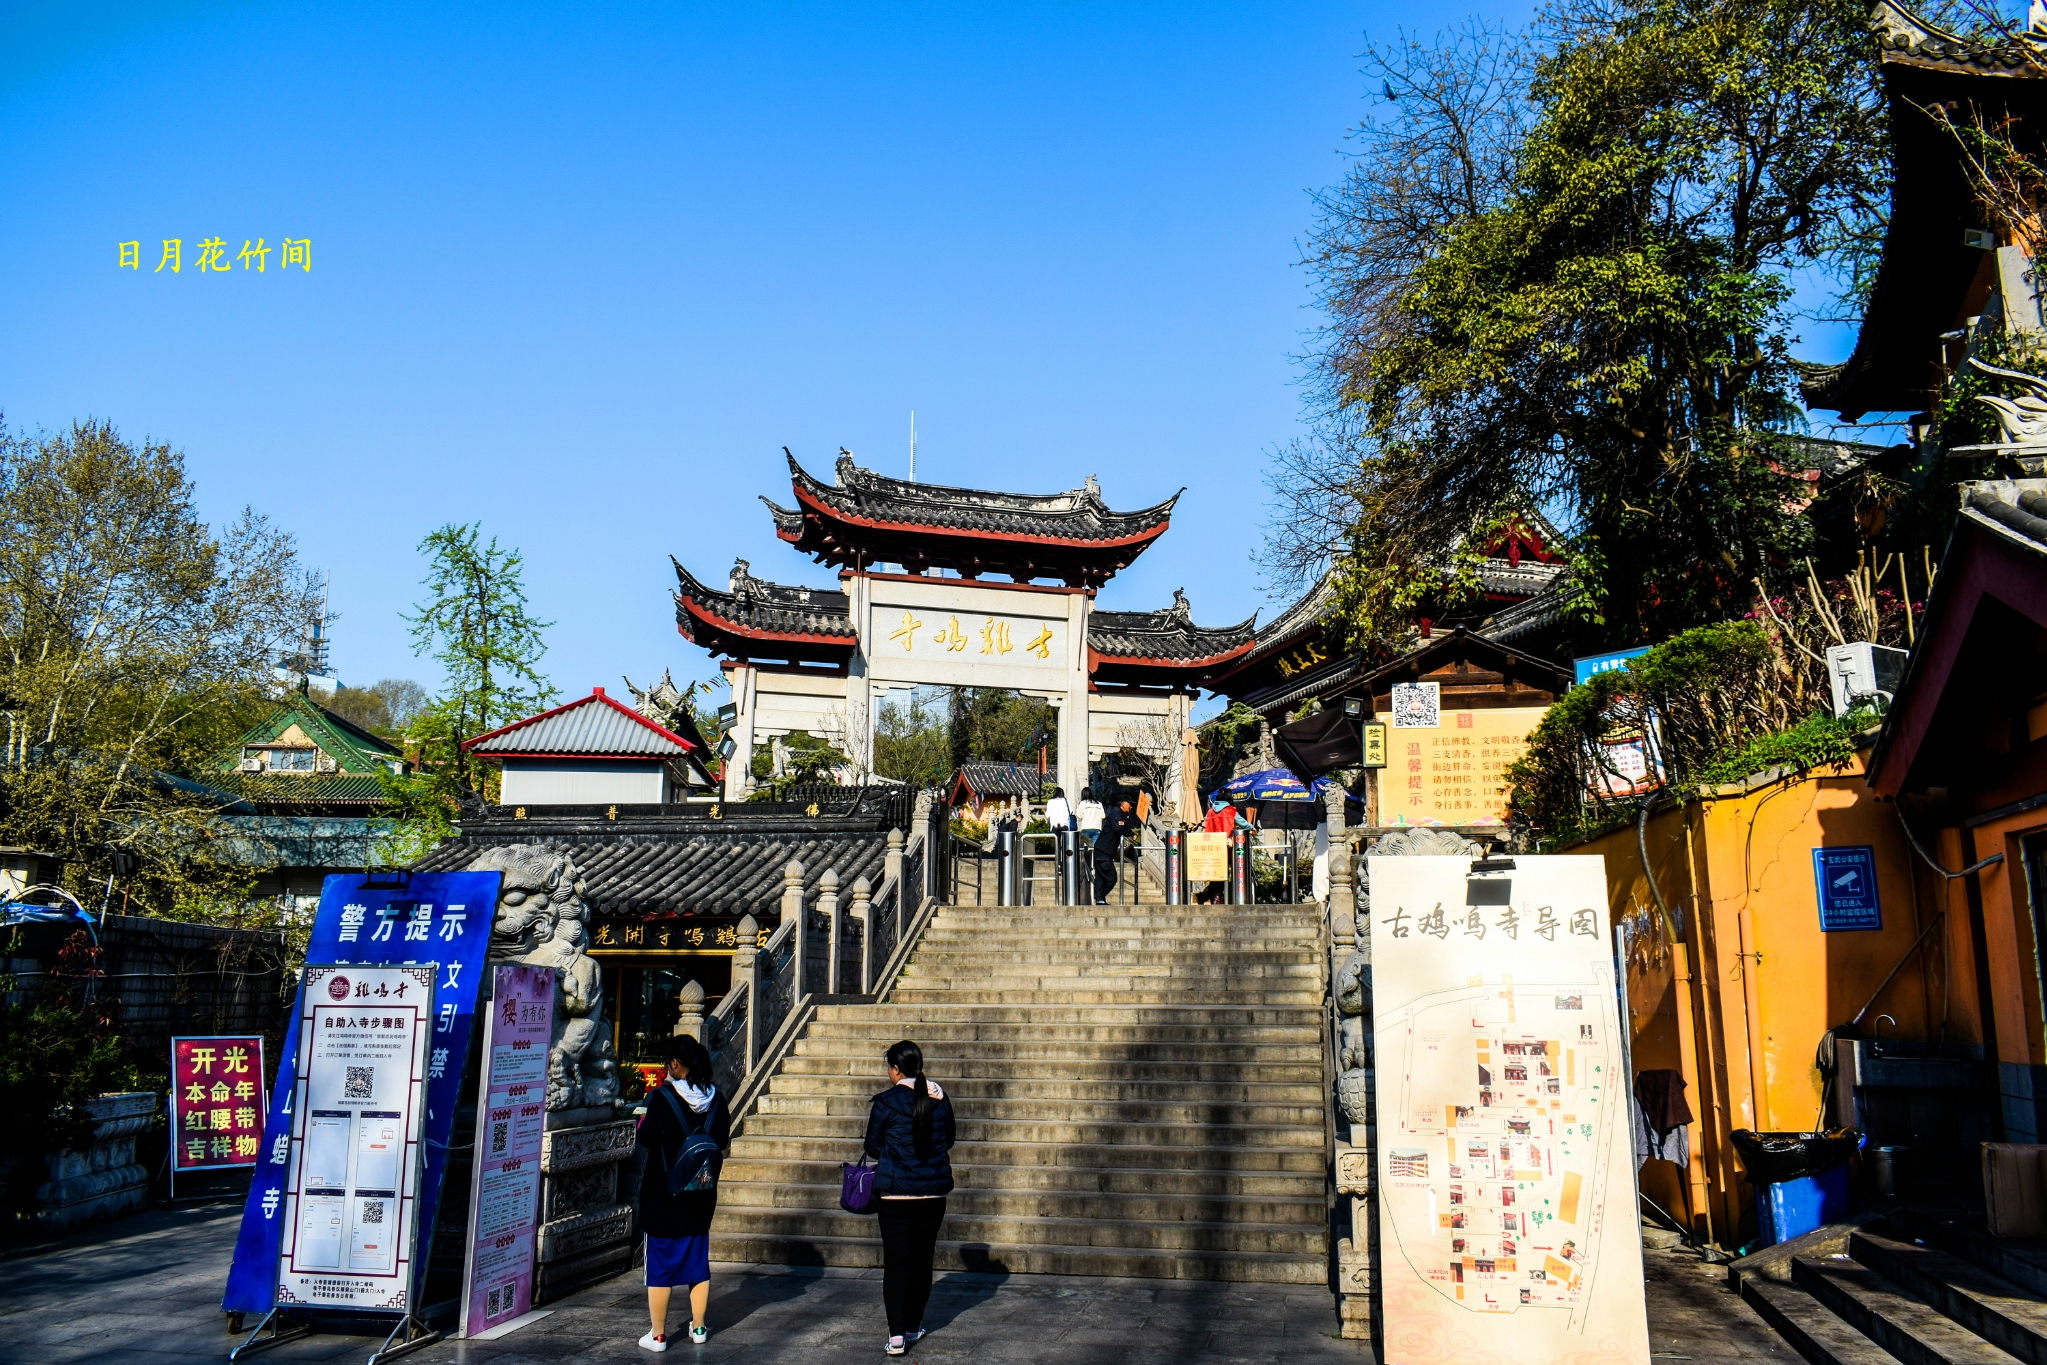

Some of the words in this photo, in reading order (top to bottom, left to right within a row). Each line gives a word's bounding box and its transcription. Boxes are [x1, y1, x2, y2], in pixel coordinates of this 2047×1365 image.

[1407, 742, 1423, 806] 温馨提示
[339, 903, 467, 943] 警方提示
[325, 1016, 405, 1029] 自助入寺步骤图
[190, 1046, 249, 1075] 开光
[185, 1080, 255, 1104] 本命年
[646, 1073, 657, 1087] 光
[185, 1107, 256, 1131] 红腰带
[185, 1134, 257, 1160] 吉祥物
